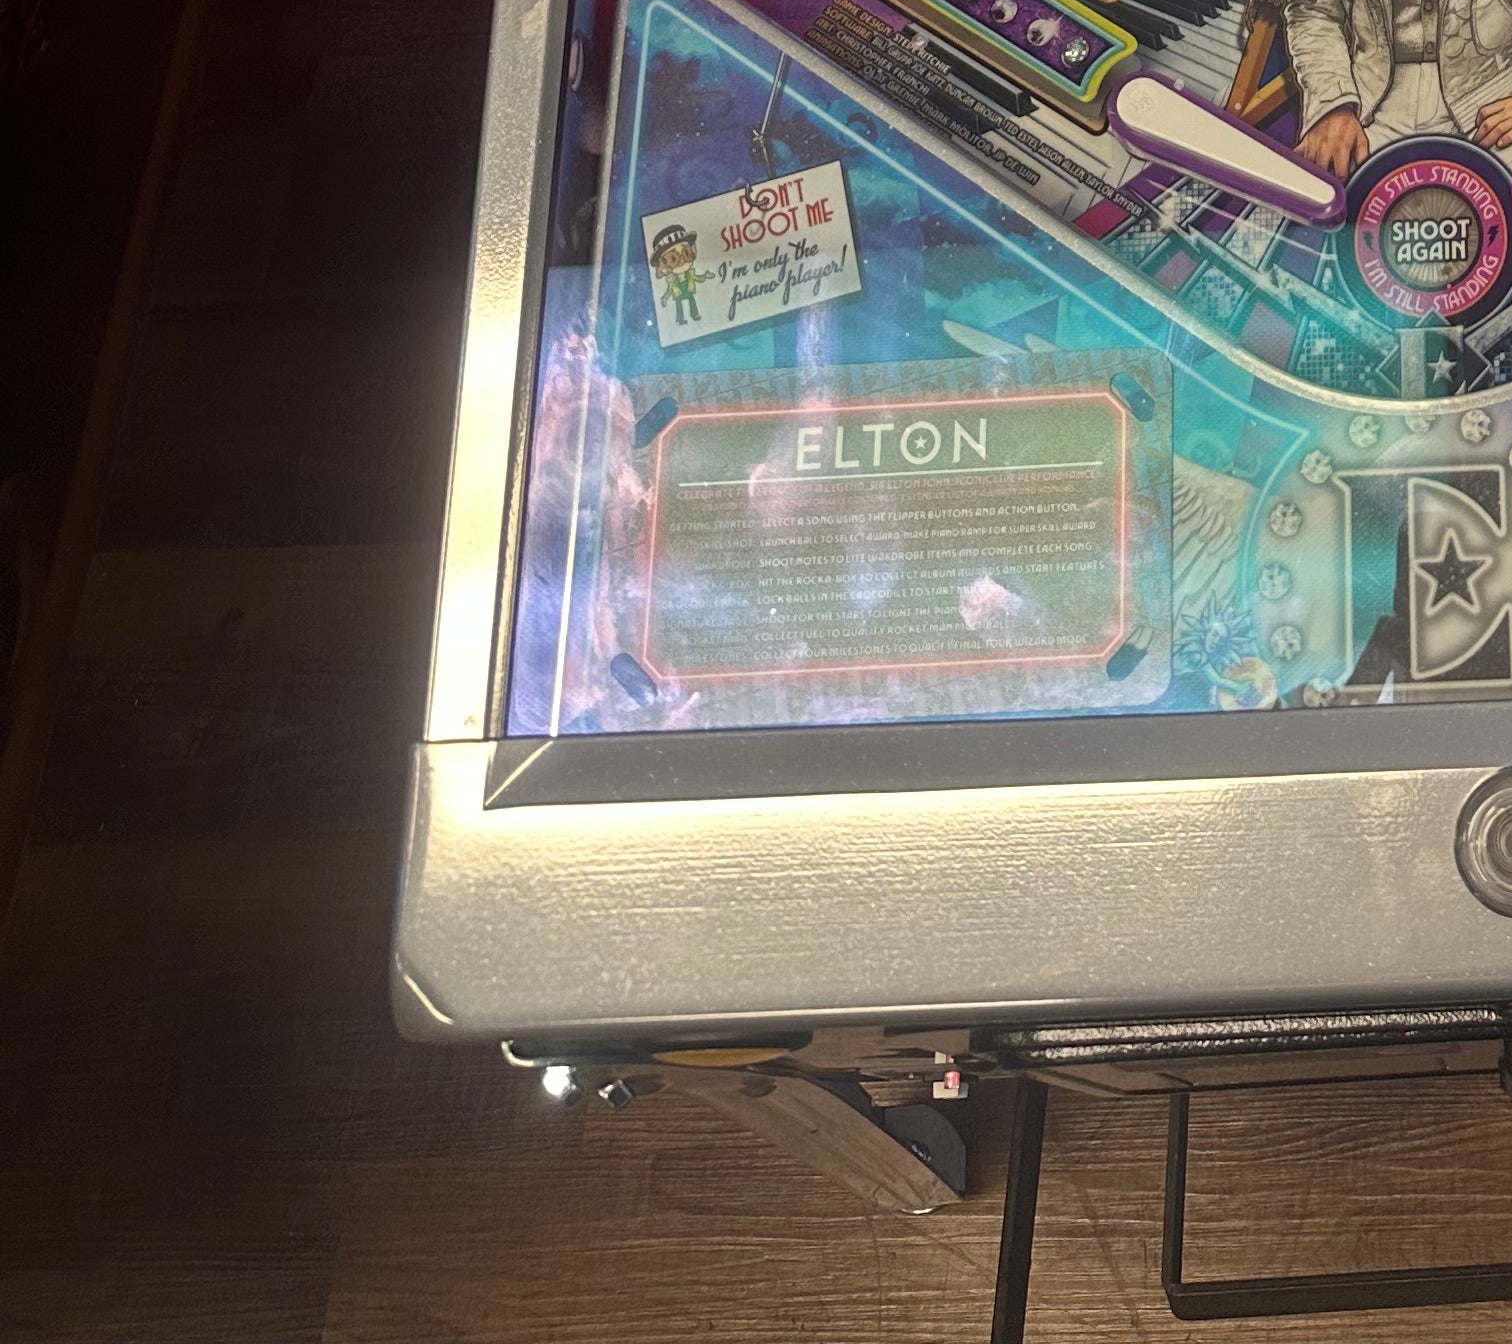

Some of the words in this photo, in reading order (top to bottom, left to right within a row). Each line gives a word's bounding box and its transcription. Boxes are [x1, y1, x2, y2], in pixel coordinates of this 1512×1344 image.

[836, 30, 893, 71] CHRISTOPHER
[893, 65, 932, 95] FRANCHI
[918, 47, 951, 75] RITCHIE
[739, 178, 804, 219] DON'T
[1113, 191, 1143, 216] SNYDER
[1364, 197, 1387, 225] I'M
[1385, 168, 1424, 198] STILL
[1430, 165, 1499, 221] STANDING
[720, 206, 799, 252] SHOOT
[806, 198, 834, 228] ME
[1392, 218, 1471, 242] SHOOT
[718, 260, 749, 283] I'm
[753, 246, 791, 282] only
[788, 238, 819, 258] the
[1397, 240, 1467, 263] AGAIN
[728, 279, 781, 321] piano
[783, 244, 848, 305] player!
[1384, 283, 1425, 313] STILL
[1433, 254, 1499, 311] STANDING
[796, 418, 987, 471] ELTON
[806, 515, 834, 526] SONG
[836, 514, 866, 524] USING
[888, 510, 926, 521] FLIPPER
[928, 508, 974, 519] BUTTONS
[975, 507, 996, 516] AND
[997, 505, 1035, 515] ACTION
